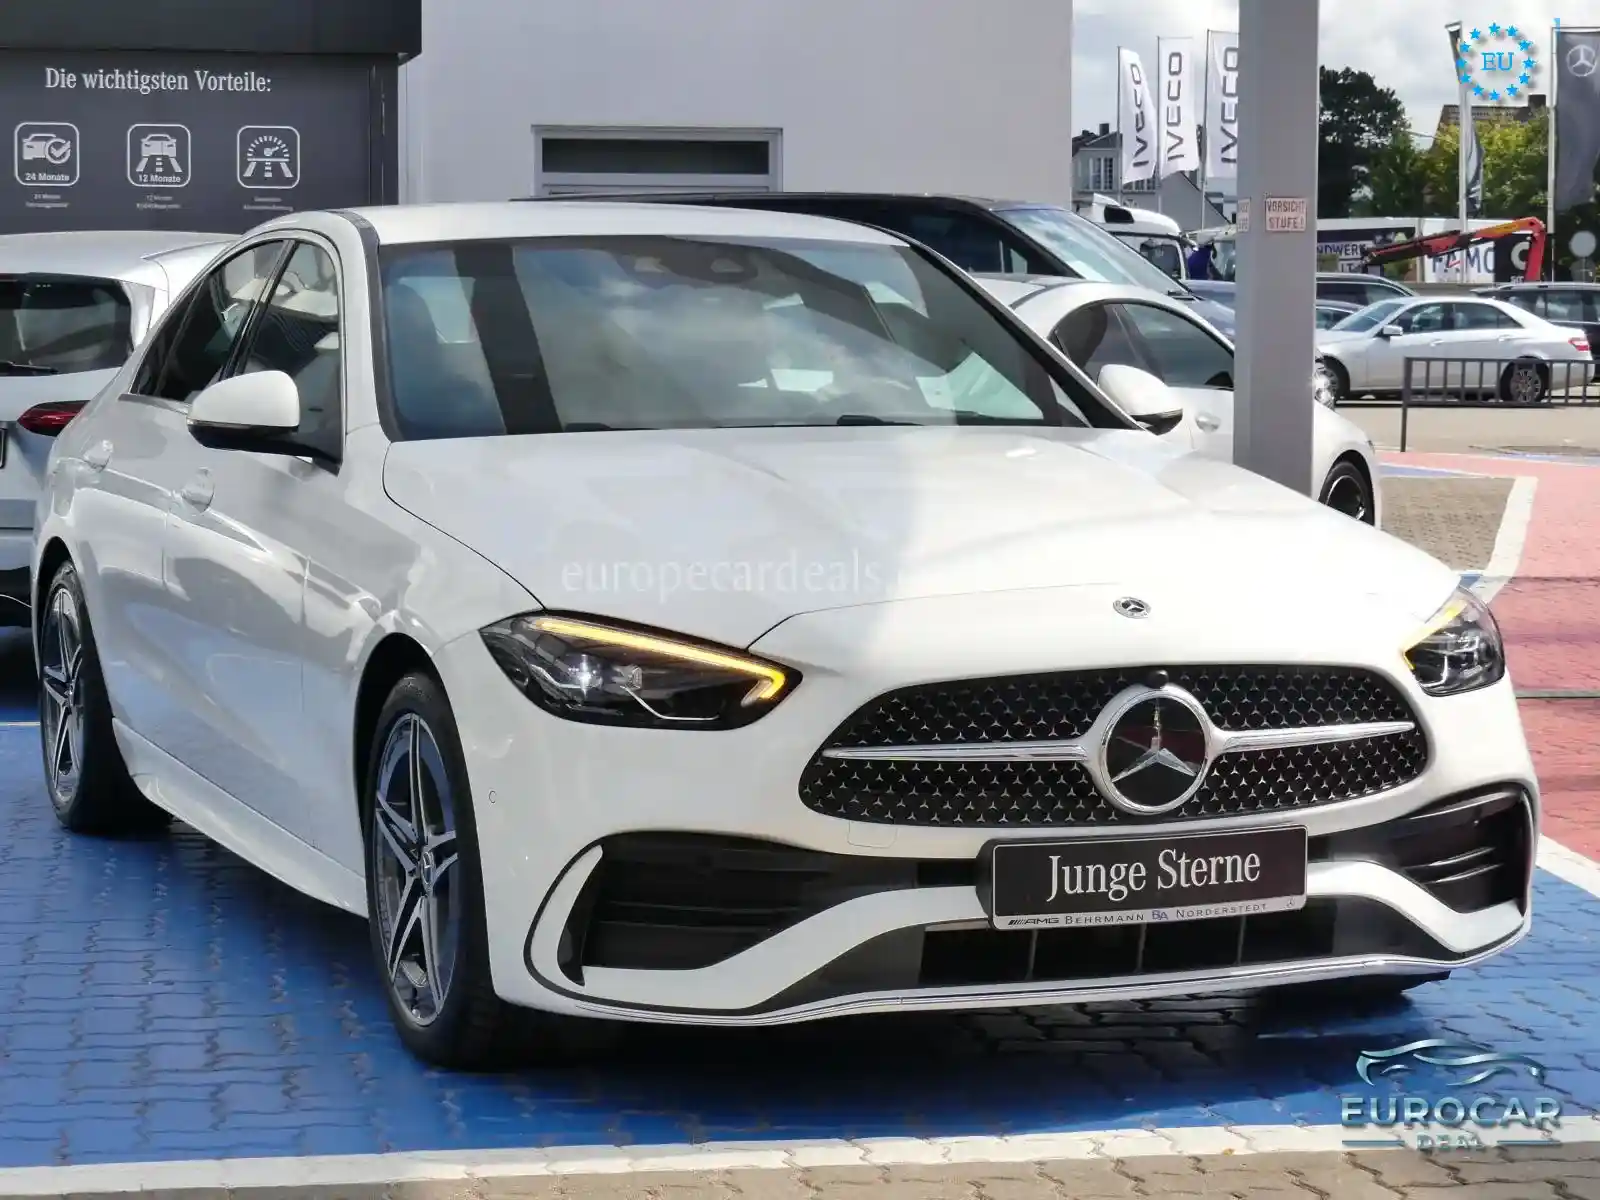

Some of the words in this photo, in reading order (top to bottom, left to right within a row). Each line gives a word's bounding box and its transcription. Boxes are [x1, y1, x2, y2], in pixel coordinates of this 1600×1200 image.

[45, 67, 77, 89] Die
[82, 67, 189, 95] wichtigsten
[195, 70, 273, 93] Vorteile:
[1131, 63, 1149, 168] IVECO
[1166, 52, 1184, 162] IVECO
[138, 174, 149, 183] 12
[150, 174, 181, 183] Monate
[1267, 200, 1305, 213] VORSICHT
[1046, 855, 1147, 902] Junge
[1157, 848, 1261, 890] Sterne
[1023, 916, 1060, 926] AMG
